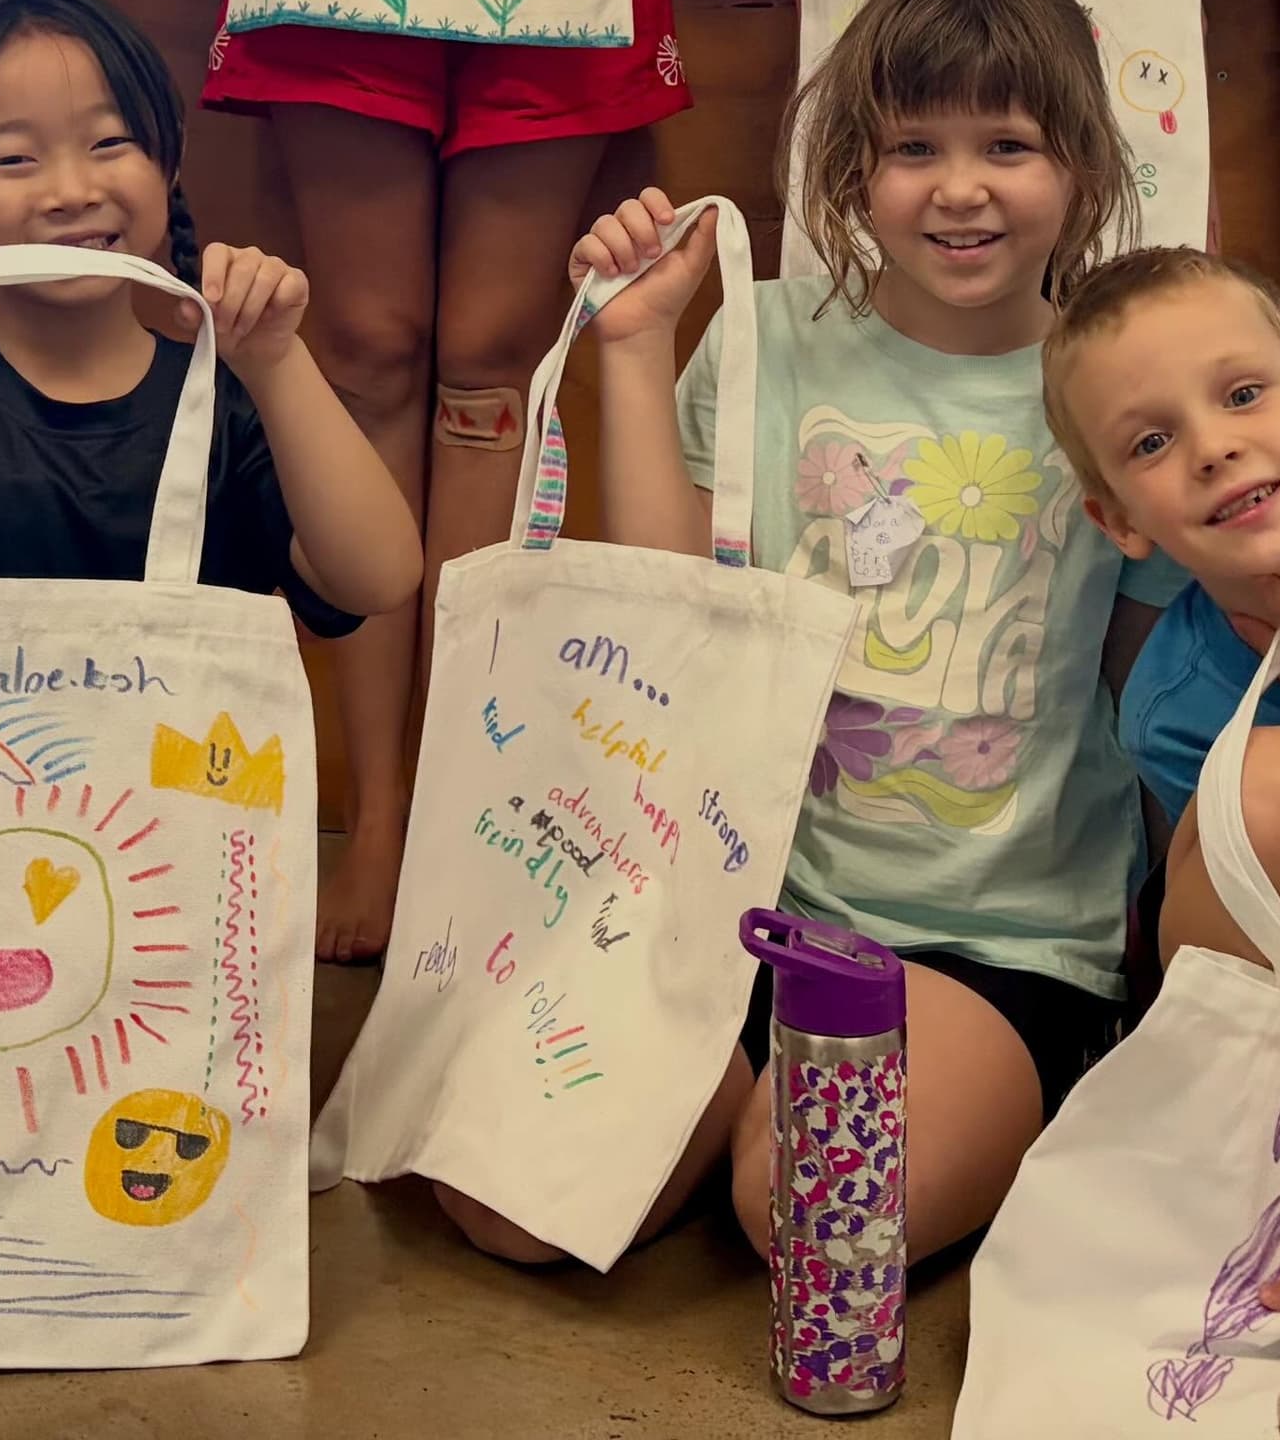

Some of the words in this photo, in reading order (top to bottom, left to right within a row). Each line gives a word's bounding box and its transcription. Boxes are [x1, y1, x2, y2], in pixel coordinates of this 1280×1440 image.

[488, 617, 500, 675] I
[482, 696, 525, 754] kind
[571, 697, 668, 774] helpful
[634, 773, 681, 867] happy
[698, 787, 750, 874] strong
[485, 931, 516, 985] to
